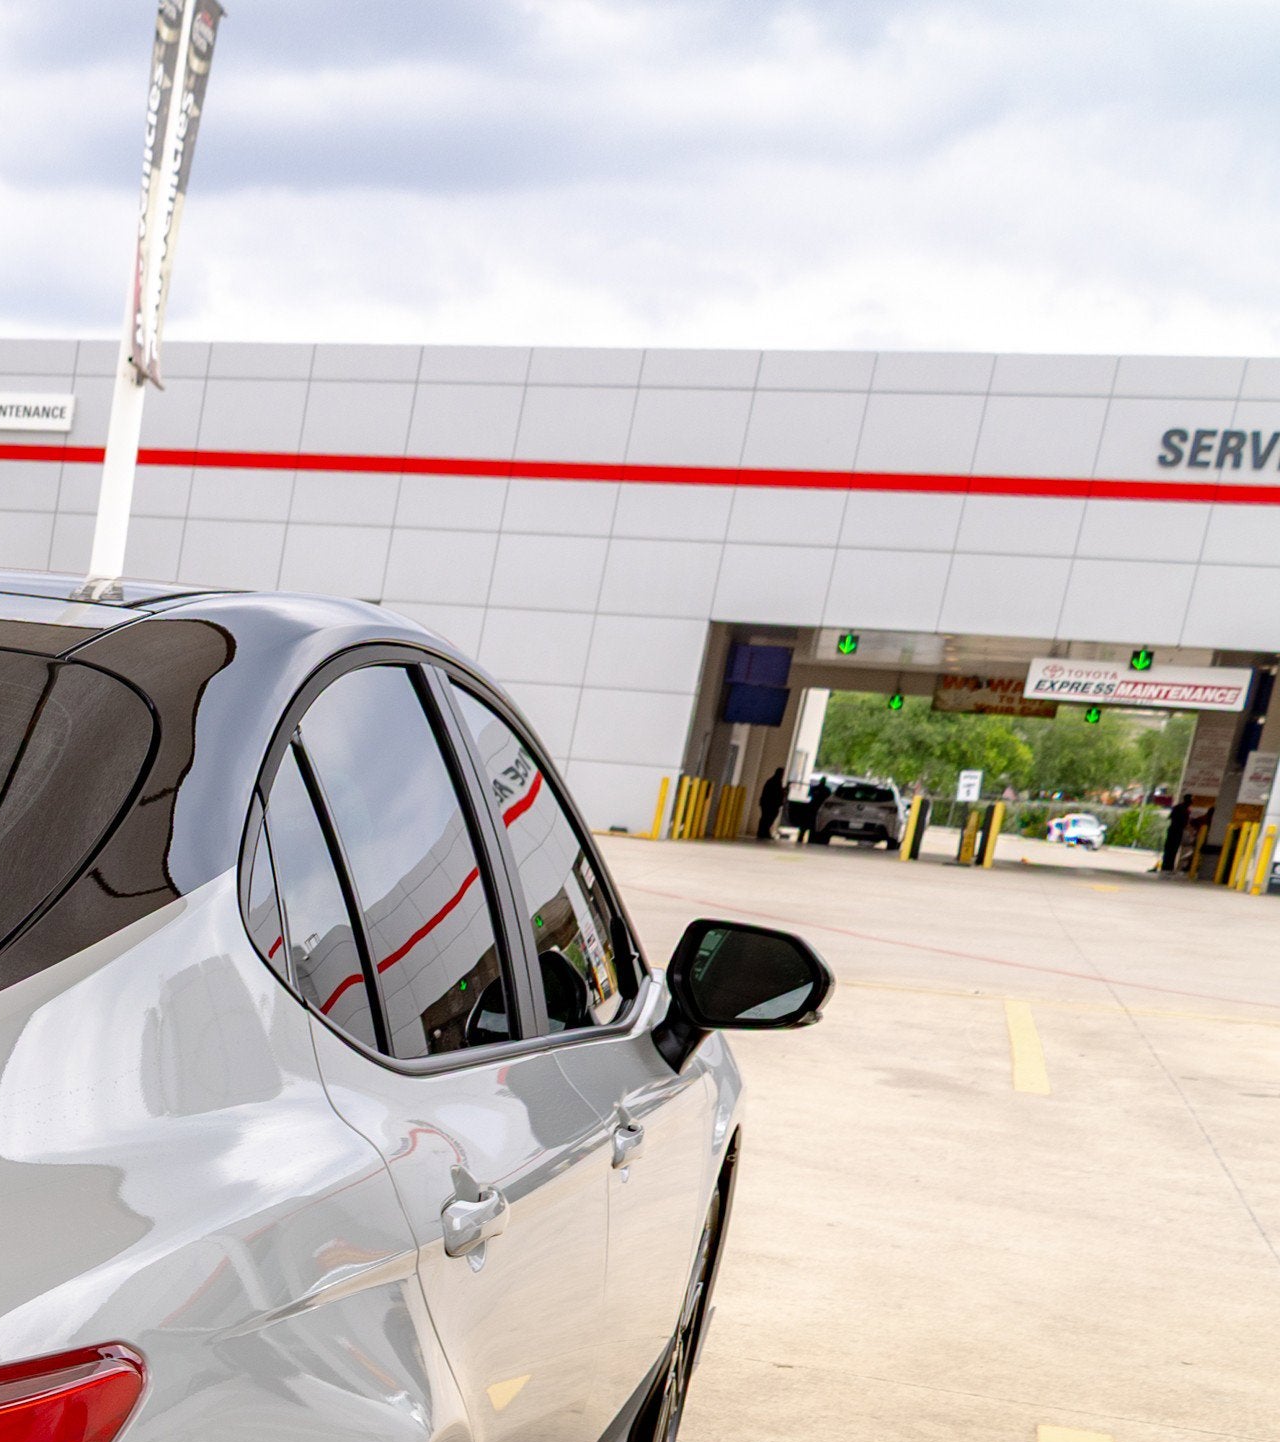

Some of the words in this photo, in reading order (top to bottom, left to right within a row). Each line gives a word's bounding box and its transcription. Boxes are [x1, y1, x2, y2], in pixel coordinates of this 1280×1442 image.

[1158, 428, 1280, 470] SERV
[1068, 669, 1118, 679] TOYOTA
[1035, 680, 1116, 695] EXPRESS
[1118, 682, 1238, 704] MAINTENANCE
